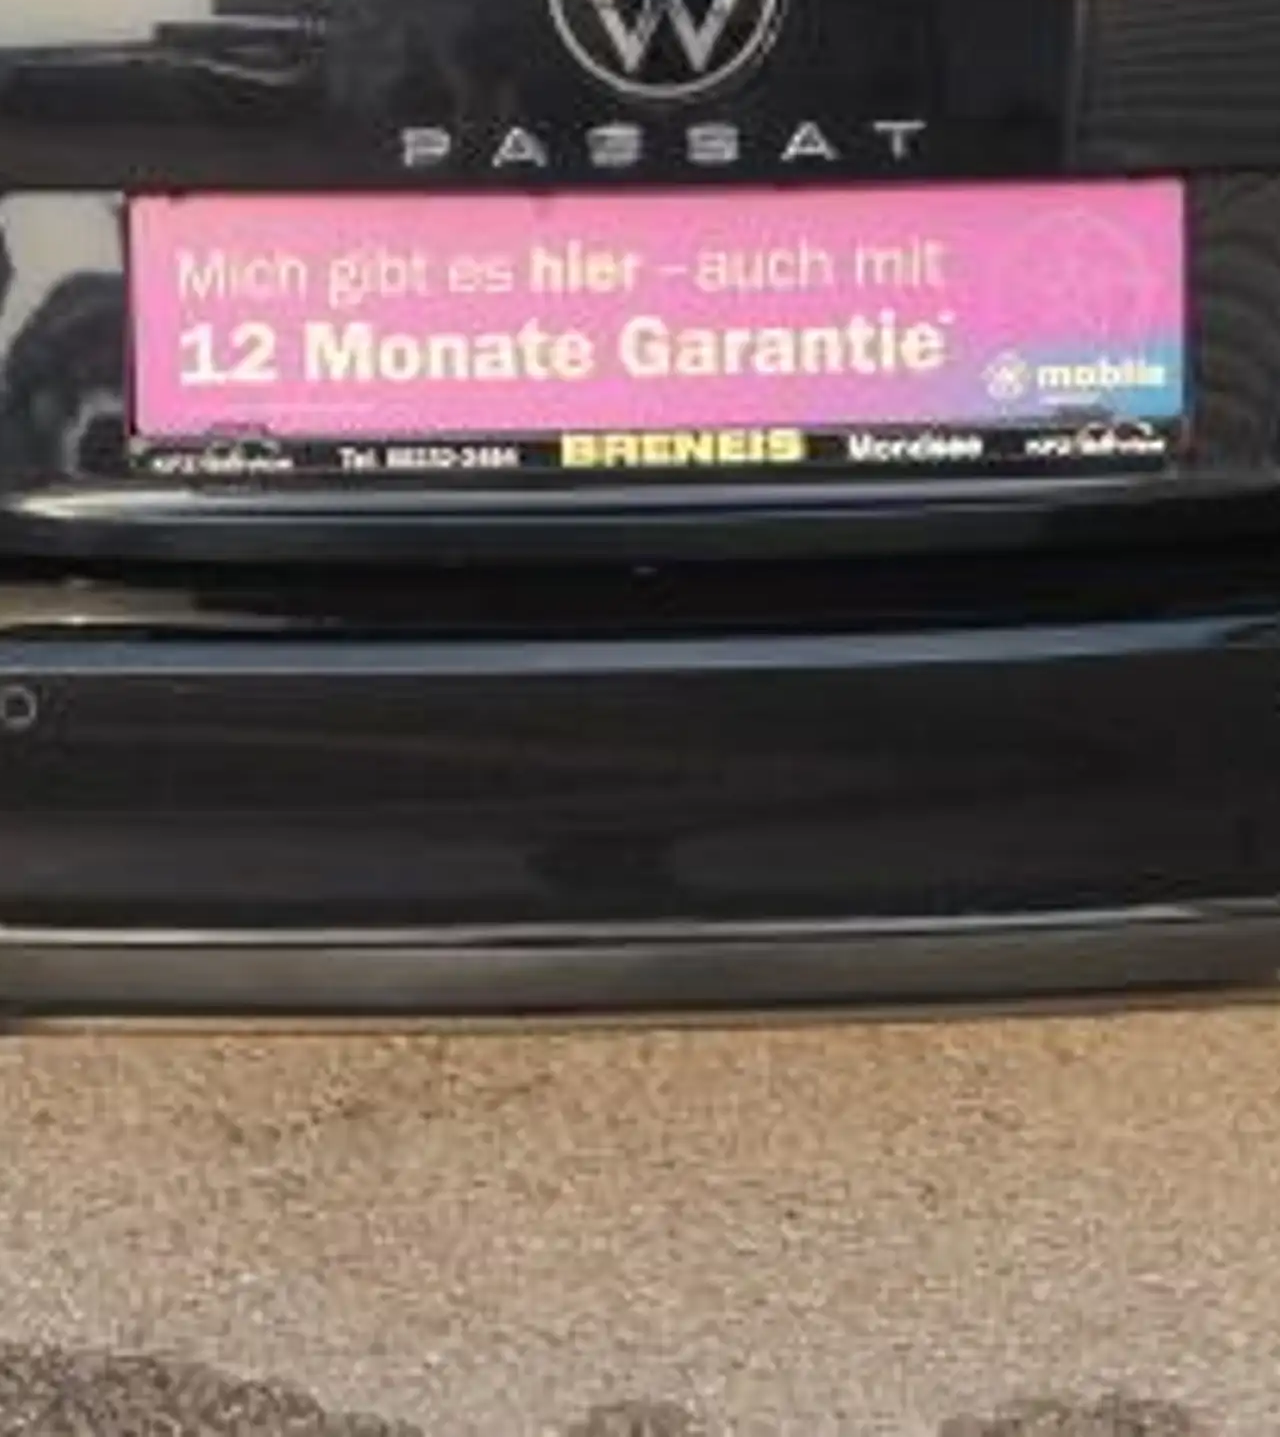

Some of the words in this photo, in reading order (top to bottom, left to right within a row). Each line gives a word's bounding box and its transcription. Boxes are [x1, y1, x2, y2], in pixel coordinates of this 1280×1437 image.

[402, 119, 926, 166] PASSAT
[177, 247, 308, 300] Mich
[329, 244, 430, 309] gibt
[447, 257, 513, 293] es
[529, 239, 638, 293] hier
[697, 238, 832, 292] auch
[855, 236, 947, 288] mit
[179, 320, 278, 385] 12
[303, 317, 595, 382] Monate
[560, 429, 805, 468] BRENEIS
